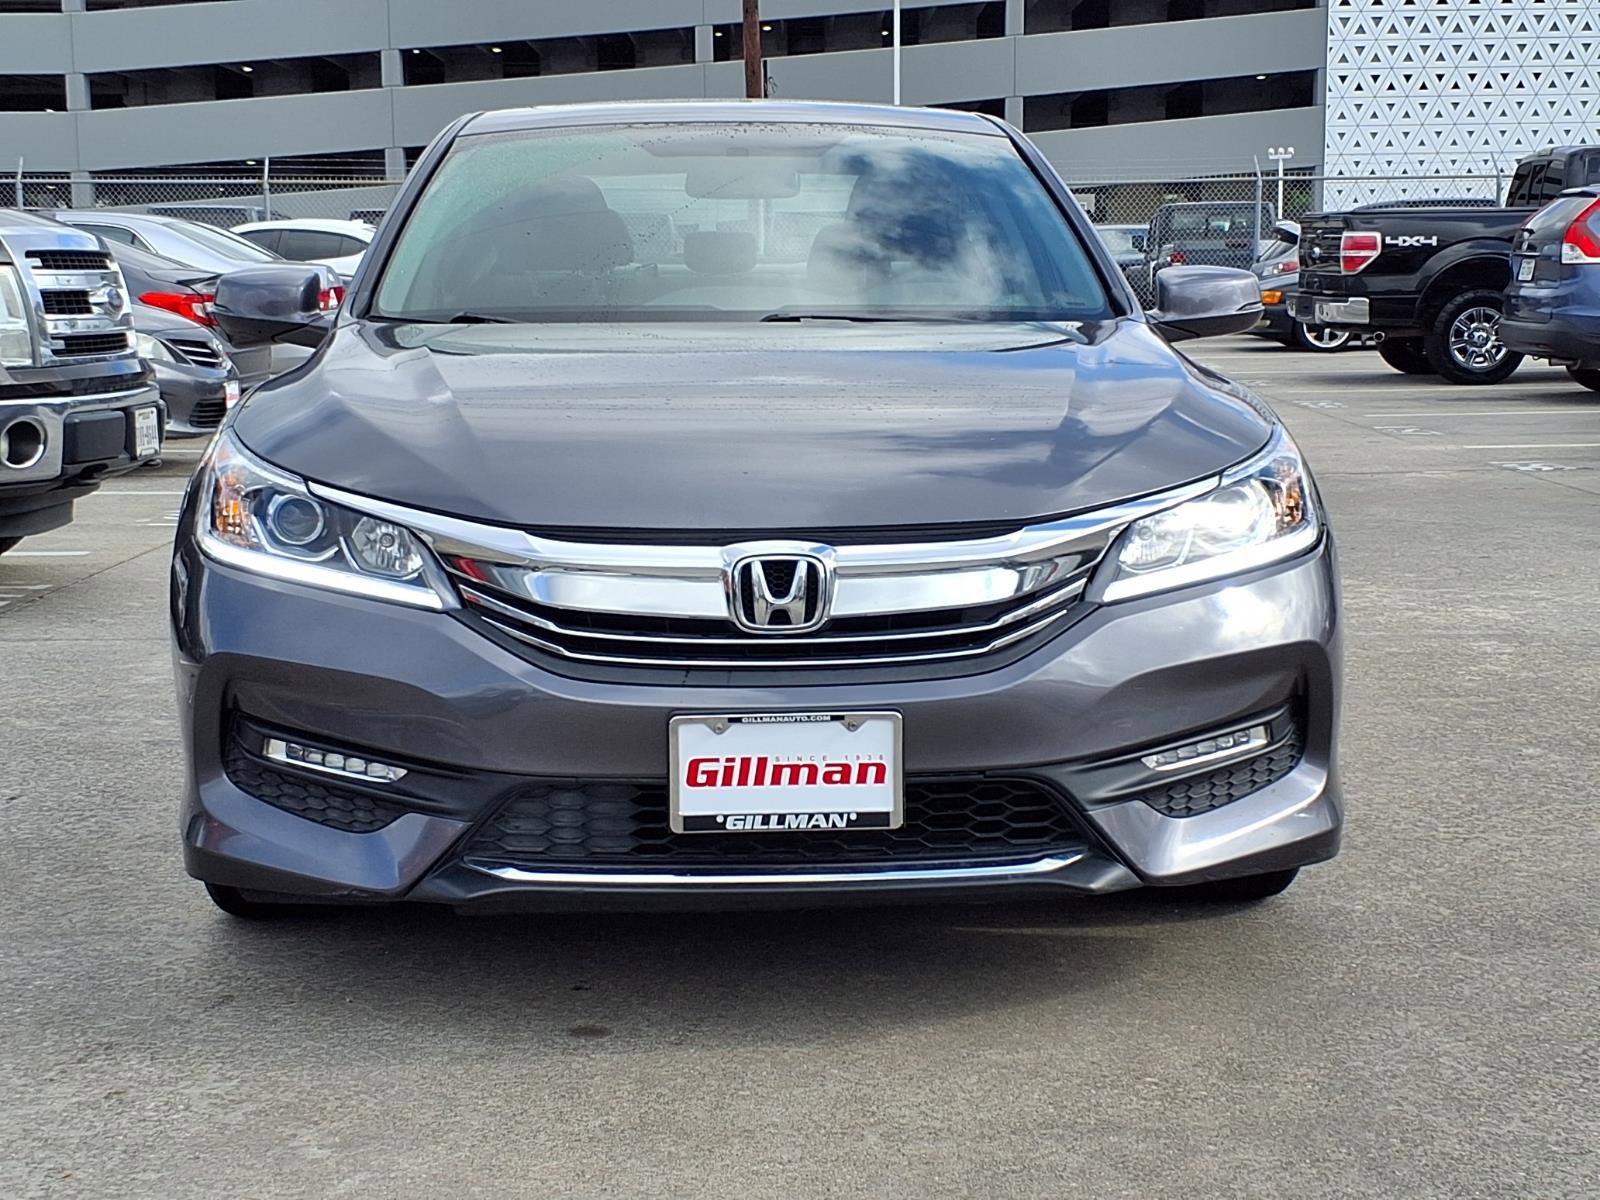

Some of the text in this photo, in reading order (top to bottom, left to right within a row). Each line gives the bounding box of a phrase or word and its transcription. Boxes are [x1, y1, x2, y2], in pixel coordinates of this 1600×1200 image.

[742, 715, 831, 723] GILLMANAUTO.COM
[685, 756, 888, 788] Gillman
[724, 813, 849, 830] GILLMAN
